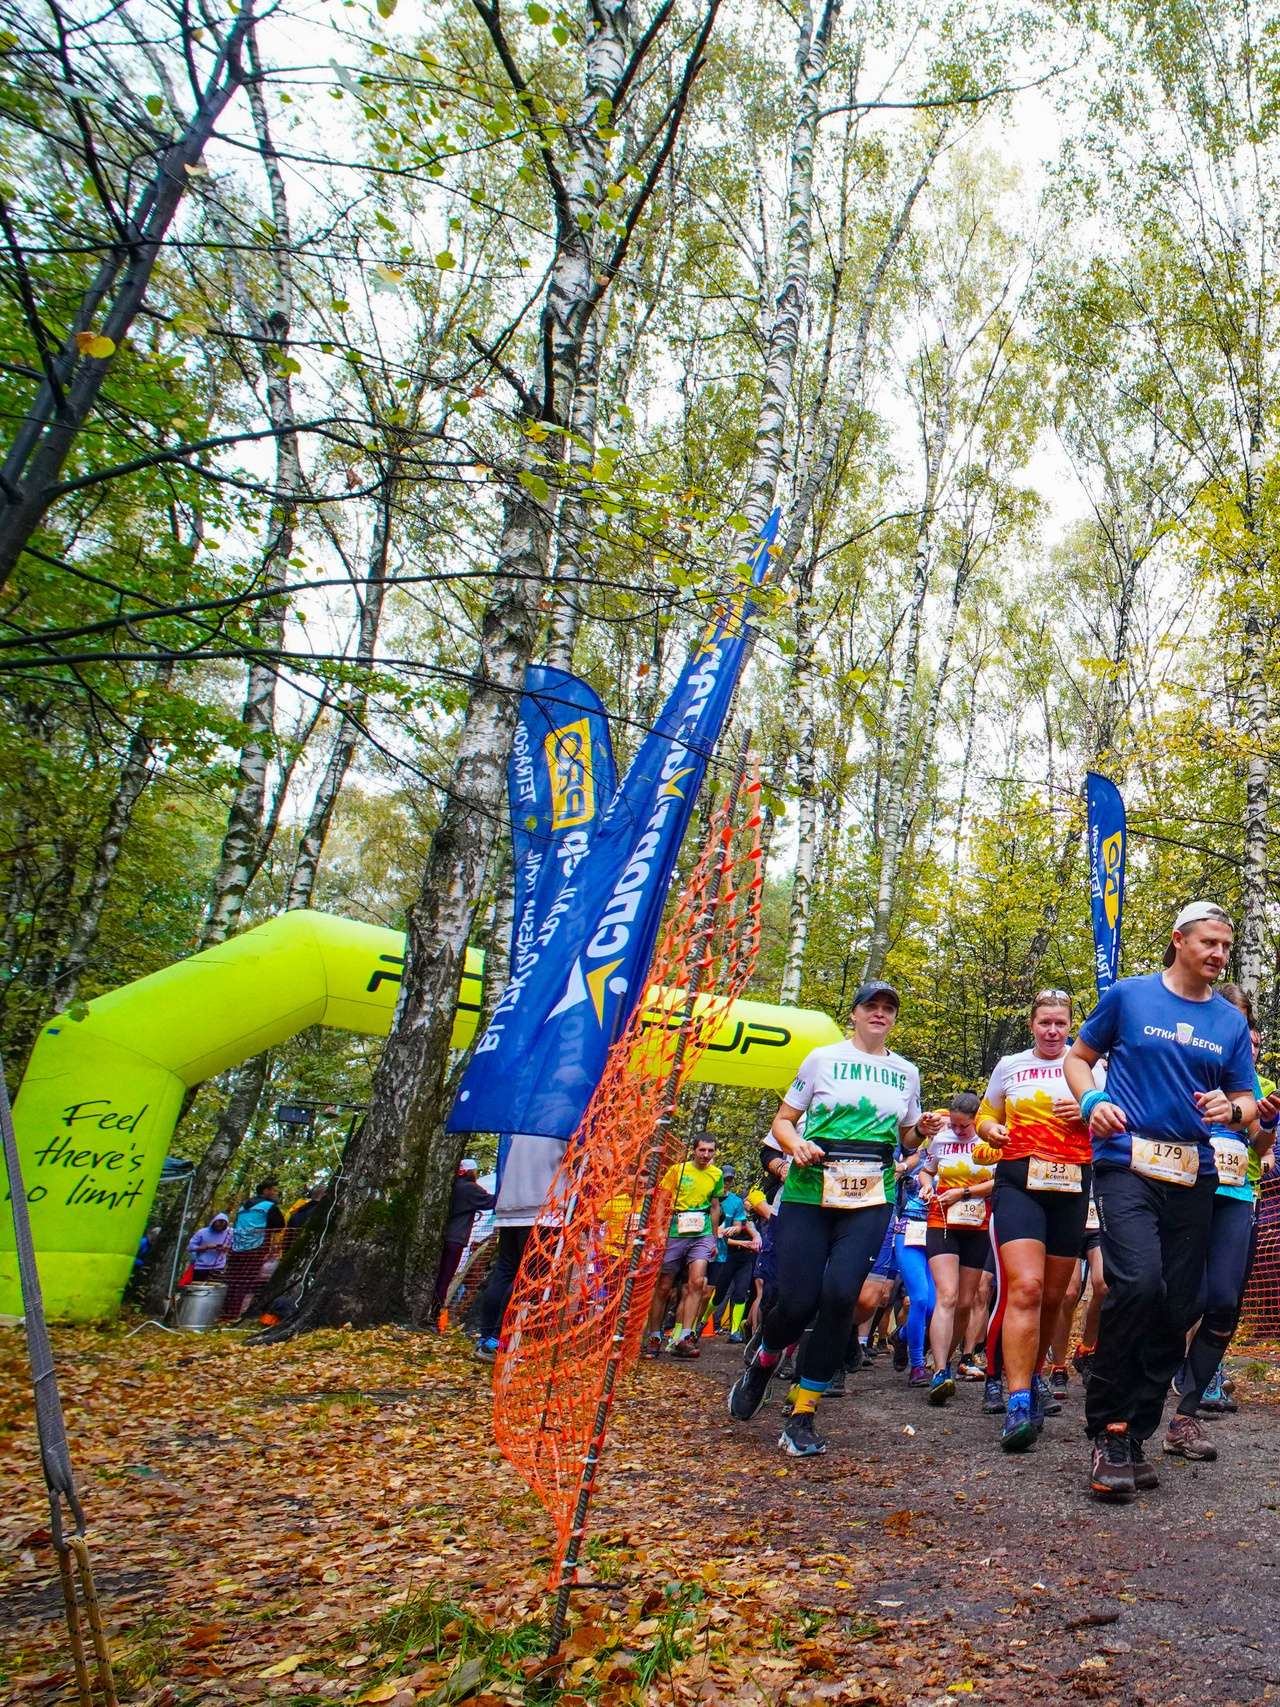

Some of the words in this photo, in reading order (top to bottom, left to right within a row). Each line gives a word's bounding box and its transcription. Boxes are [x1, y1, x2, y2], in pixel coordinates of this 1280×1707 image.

[1143, 1025, 1176, 1041] СУТКИ
[1192, 1037, 1223, 1055] БЕГОМ
[833, 1063, 907, 1092] IZMYLONG
[1017, 1068, 1062, 1083] IZMYLO
[62, 1100, 149, 1133] Feel
[34, 1136, 145, 1173] there's
[943, 1142, 976, 1155] IZMYLO
[1154, 1143, 1182, 1160] 179
[1050, 1162, 1066, 1173] 33
[1218, 1153, 1239, 1167] 134
[65, 1174, 145, 1210] limit
[841, 1178, 867, 1190] 119
[964, 1204, 976, 1212] 10
